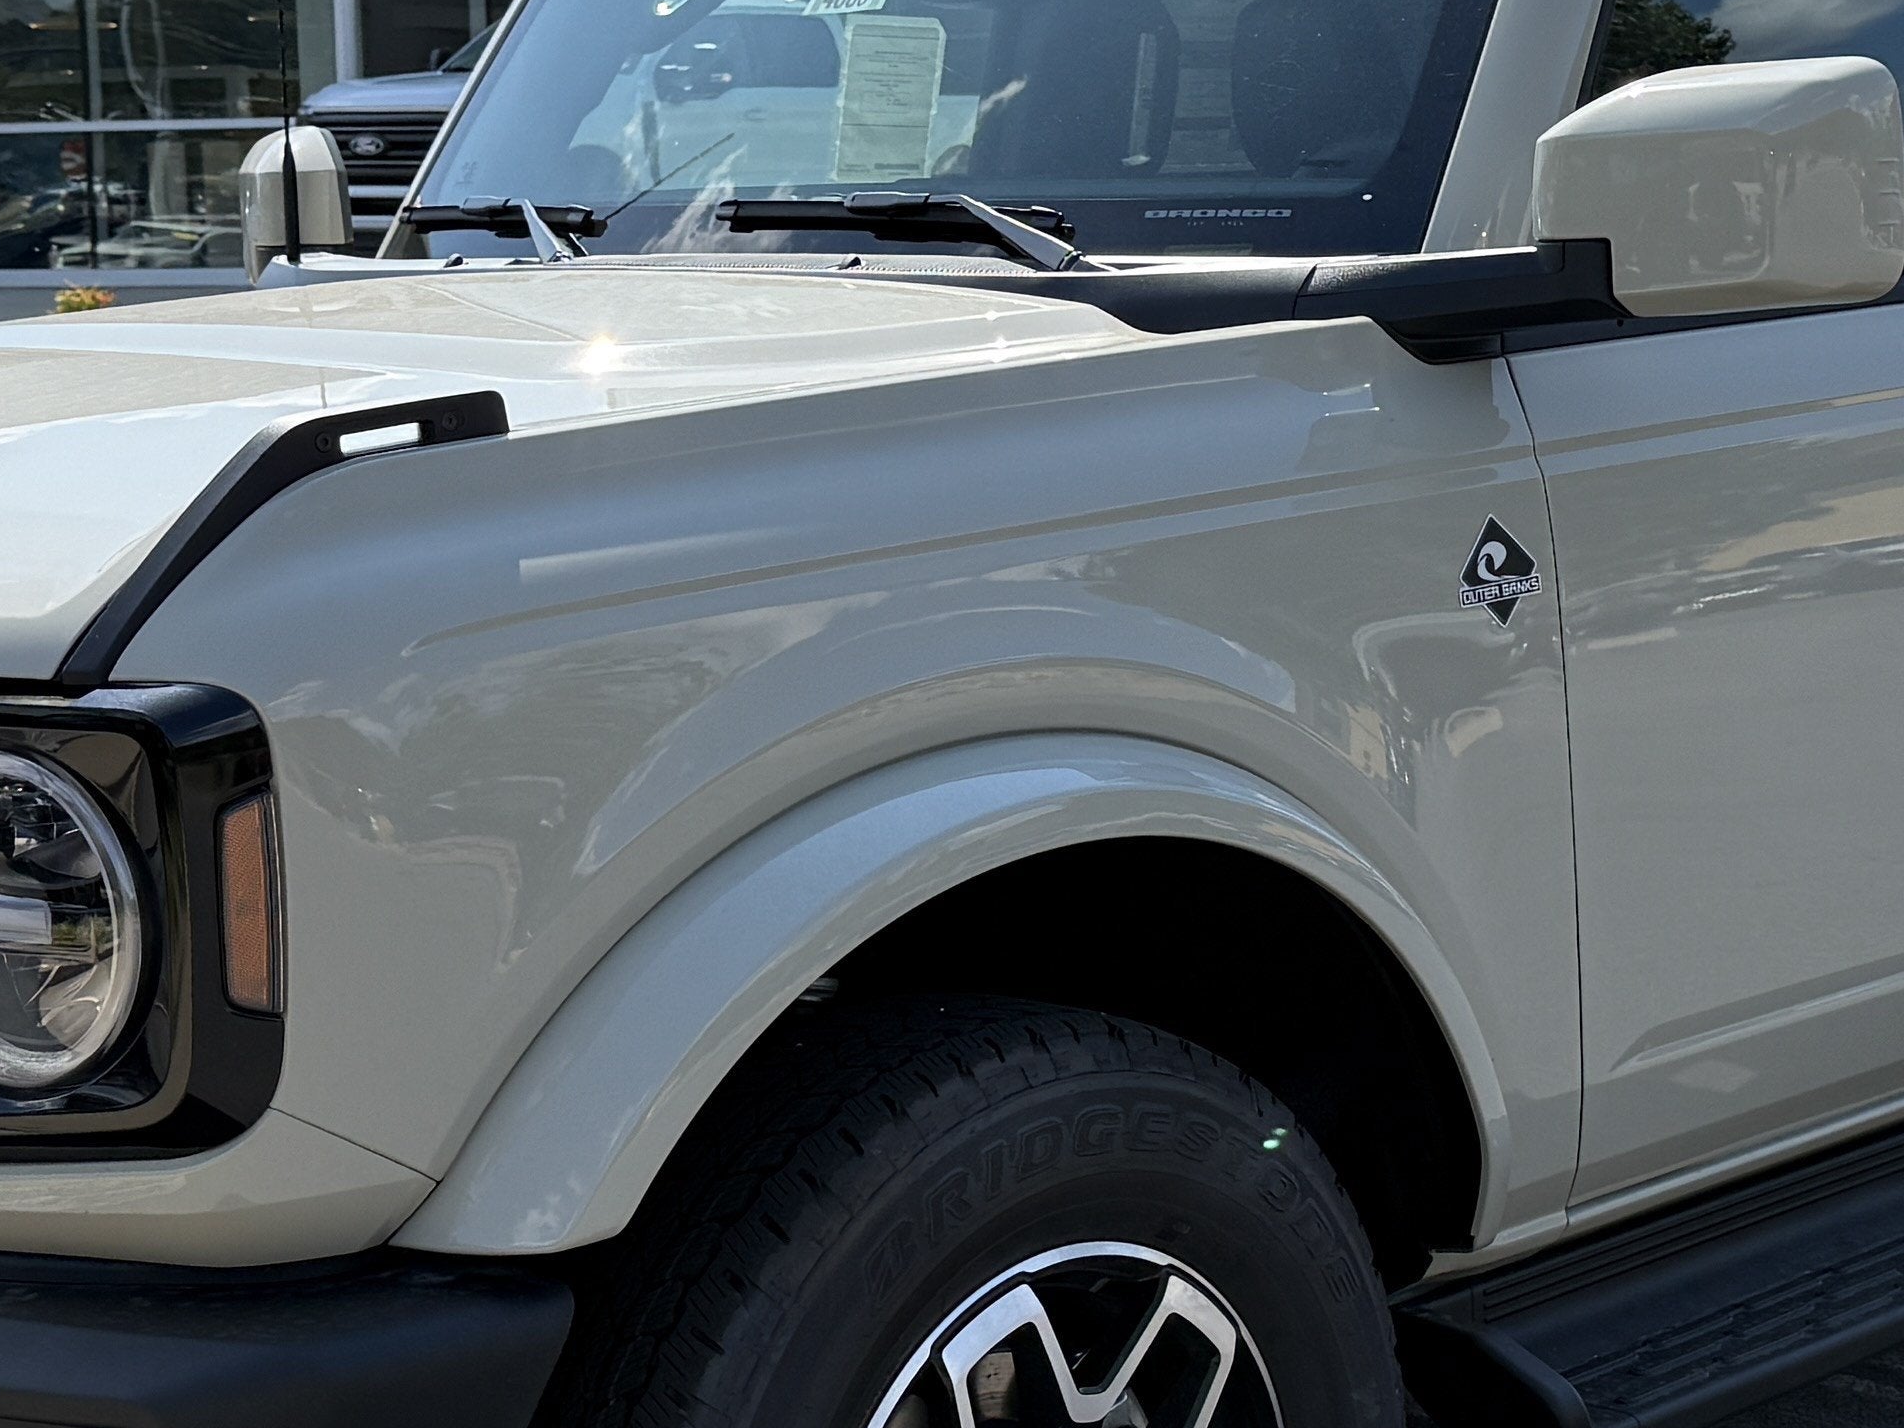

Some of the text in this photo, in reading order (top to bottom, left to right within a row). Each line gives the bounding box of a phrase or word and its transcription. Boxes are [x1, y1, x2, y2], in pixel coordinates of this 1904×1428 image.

[1463, 577, 1539, 604] OUTER BANKS
[862, 1103, 1365, 1303] BRIDGESTONE
